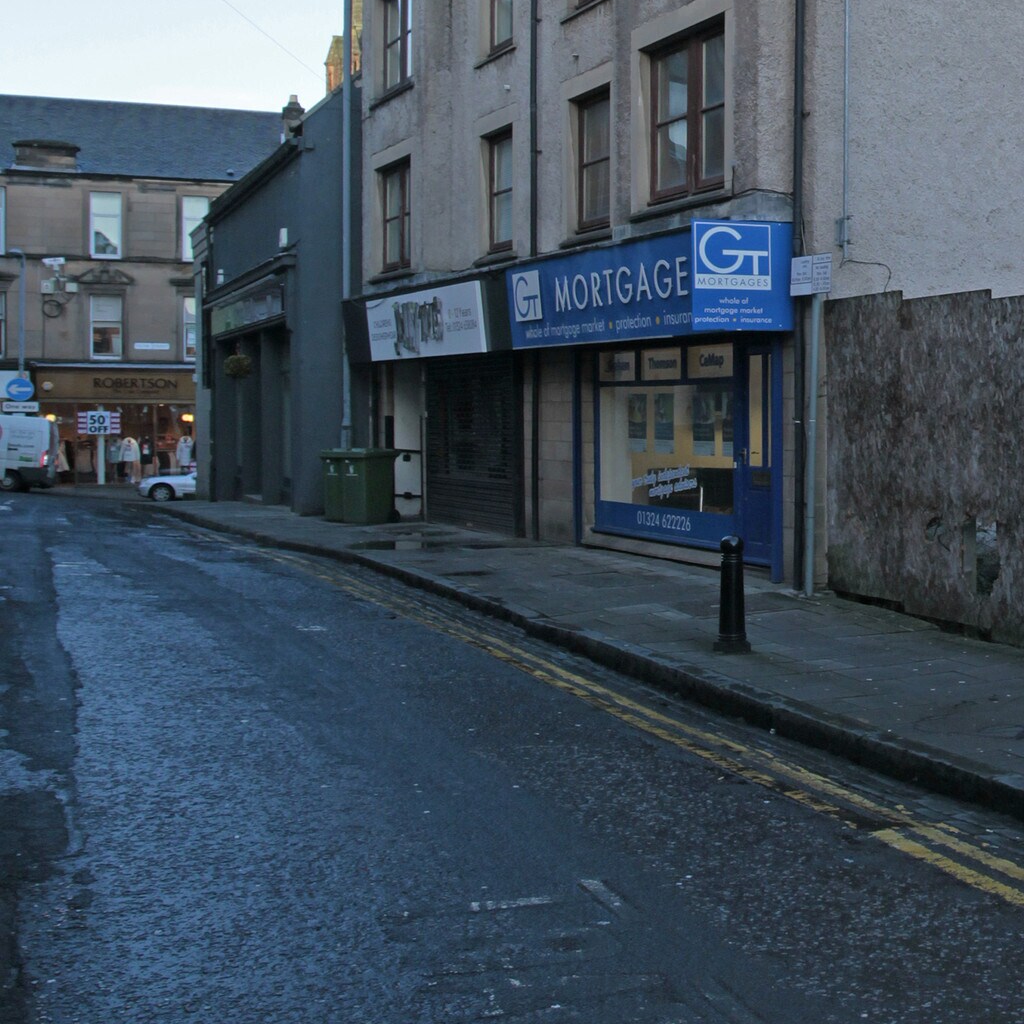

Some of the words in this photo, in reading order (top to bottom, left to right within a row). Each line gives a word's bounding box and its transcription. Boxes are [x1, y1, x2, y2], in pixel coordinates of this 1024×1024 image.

[555, 256, 689, 313] MORTGAGE
[697, 277, 769, 287] MORTGAGES
[704, 307, 738, 315] mortgage
[694, 316, 730, 324] protection
[740, 316, 772, 324] insurance
[525, 324, 543, 338] whole
[543, 323, 550, 337] of
[551, 322, 581, 338] mortgage
[581, 318, 605, 334] market
[615, 313, 652, 333] protection
[93, 377, 178, 388] ROBERTSON
[89, 426, 109, 434] OFF
[636, 510, 660, 527] 01324
[661, 513, 691, 532] 622226
